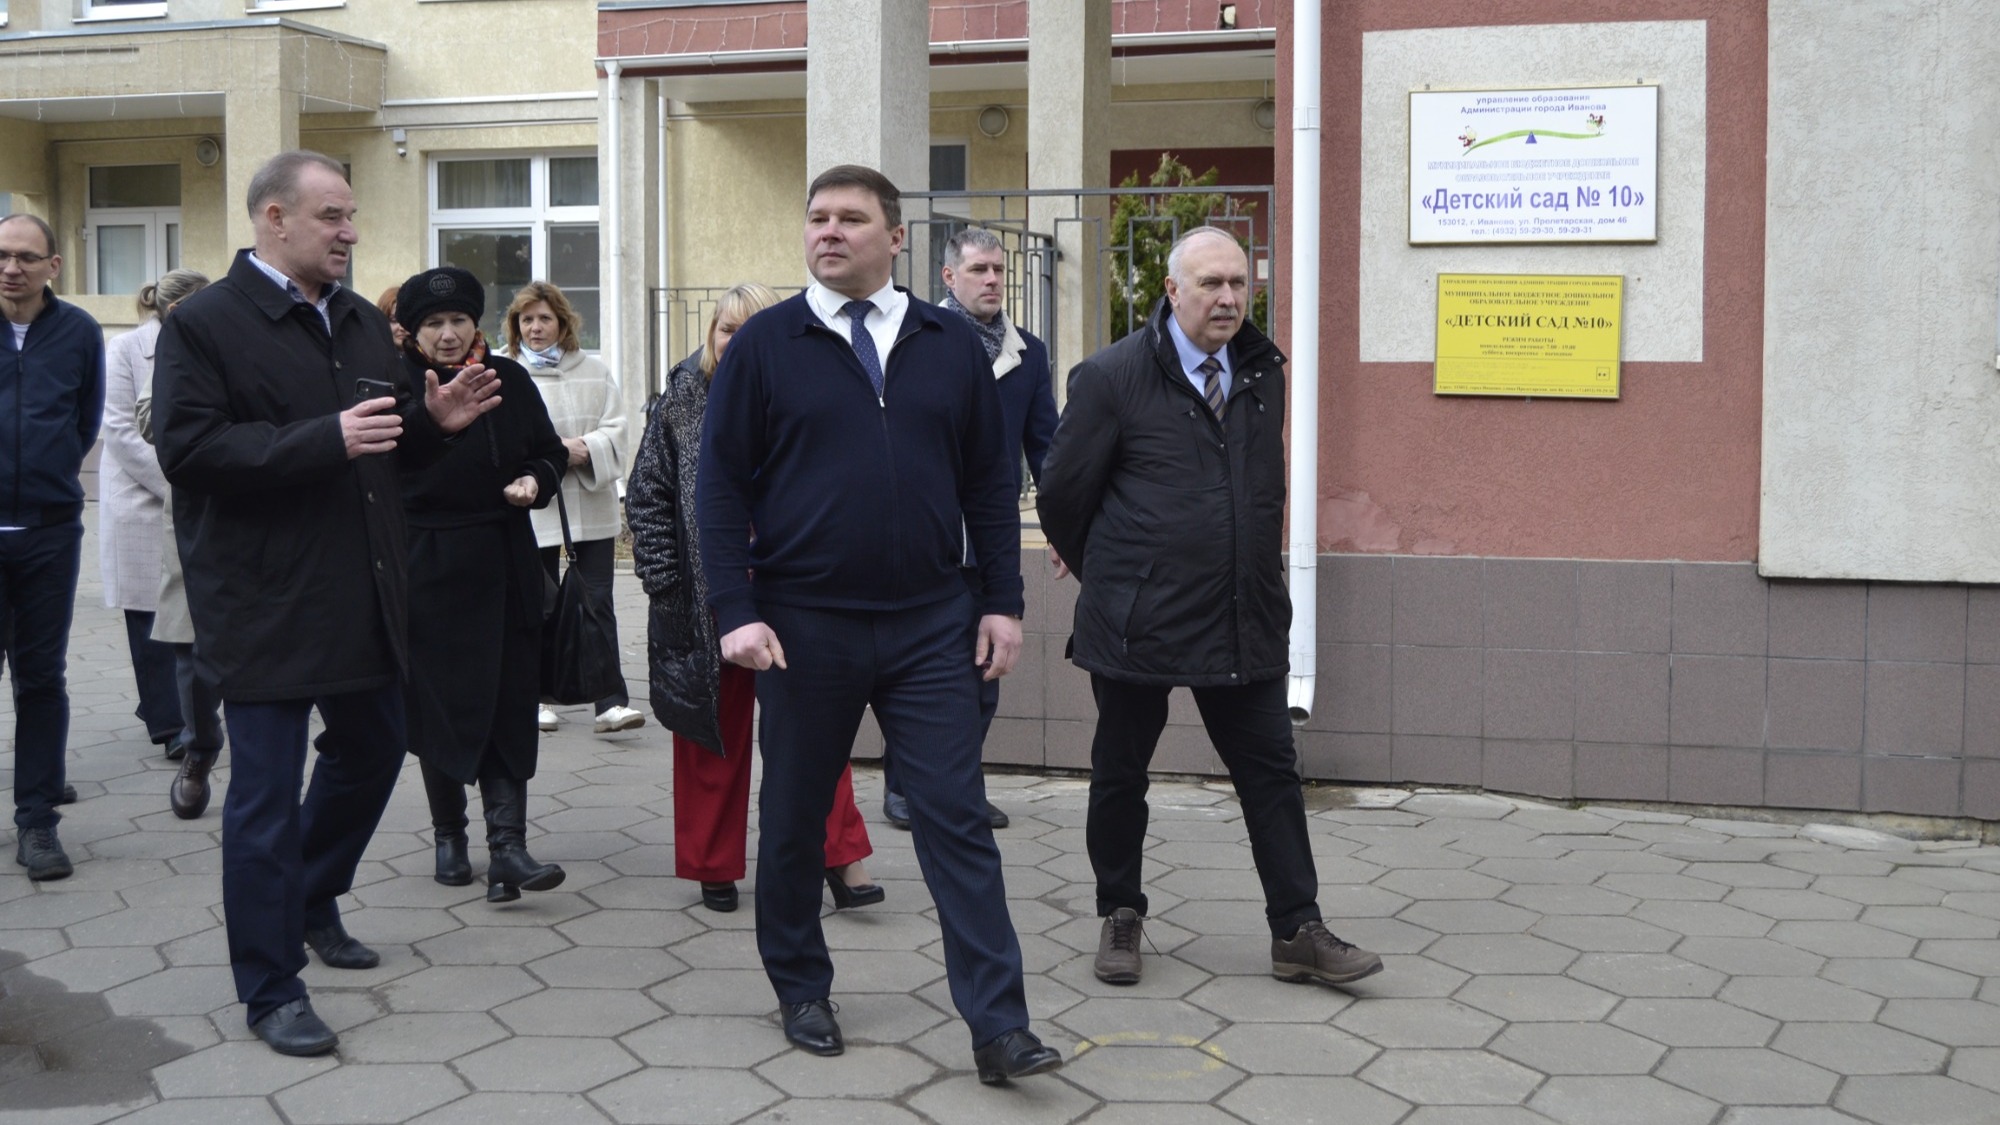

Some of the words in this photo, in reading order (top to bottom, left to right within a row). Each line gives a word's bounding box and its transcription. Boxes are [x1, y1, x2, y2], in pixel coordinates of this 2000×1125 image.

[1476, 96, 1529, 105] управление
[1531, 95, 1590, 103] образования
[1460, 105, 1532, 114] Администрации
[1534, 104, 1565, 113] города
[1568, 103, 1606, 111] Иванова
[1422, 186, 1522, 214] «Детский
[1530, 191, 1569, 212] сад
[1577, 186, 1600, 207] №
[1609, 185, 1644, 207] 10»
[1445, 313, 1531, 328] «ДЕТСКИЙ
[1536, 315, 1569, 330] САД
[1572, 316, 1613, 329] №10»
